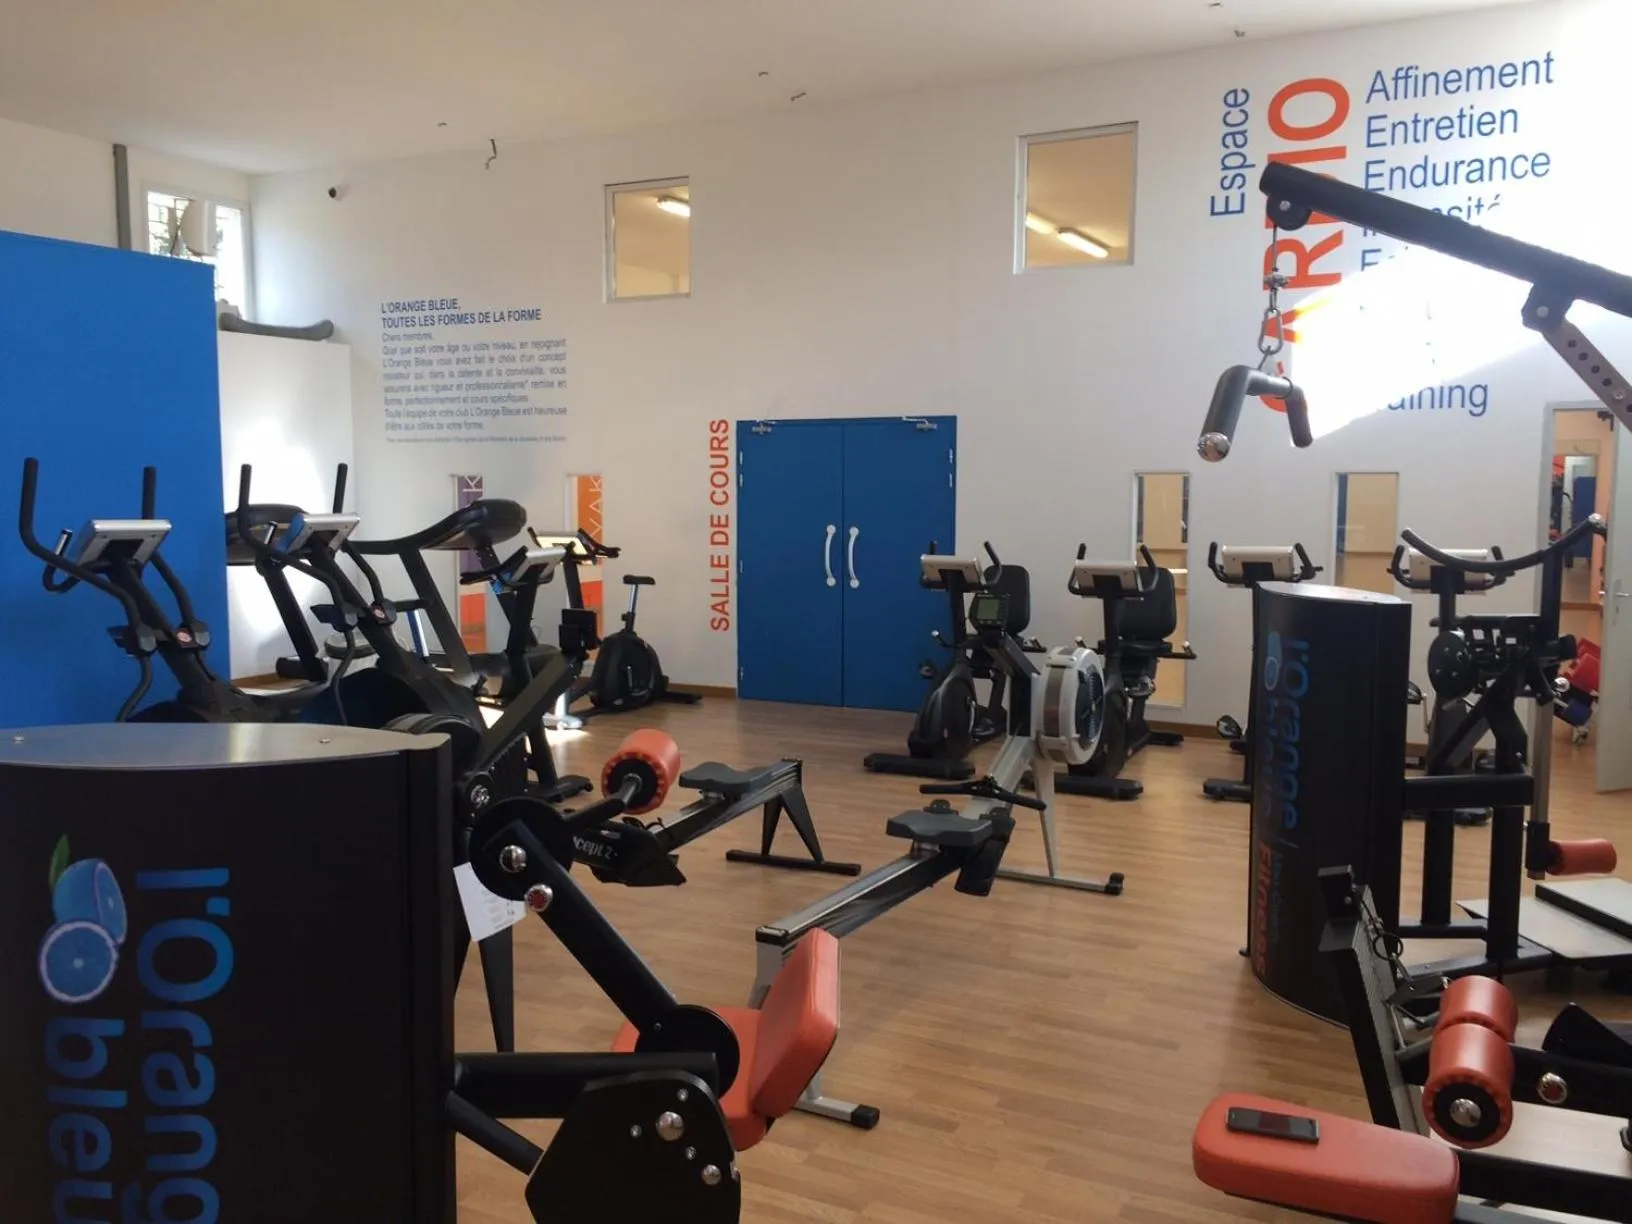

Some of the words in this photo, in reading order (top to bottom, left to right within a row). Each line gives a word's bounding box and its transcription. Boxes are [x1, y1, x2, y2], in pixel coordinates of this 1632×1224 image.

[1366, 52, 1554, 103] Affinement
[1366, 105, 1518, 149] Entretien
[1210, 87, 1255, 217] Espace
[1364, 151, 1551, 192] Endurance
[381, 300, 426, 313] L'ORANGE
[382, 315, 416, 328] TOUTES
[418, 314, 435, 327] LES
[438, 312, 476, 325] FORMES
[478, 311, 491, 323] DE
[493, 310, 505, 322] LA
[508, 308, 541, 321] FORME
[1387, 380, 1488, 417] ining
[710, 419, 729, 506] COURS
[710, 513, 729, 546] DE
[710, 554, 730, 631] SALLE
